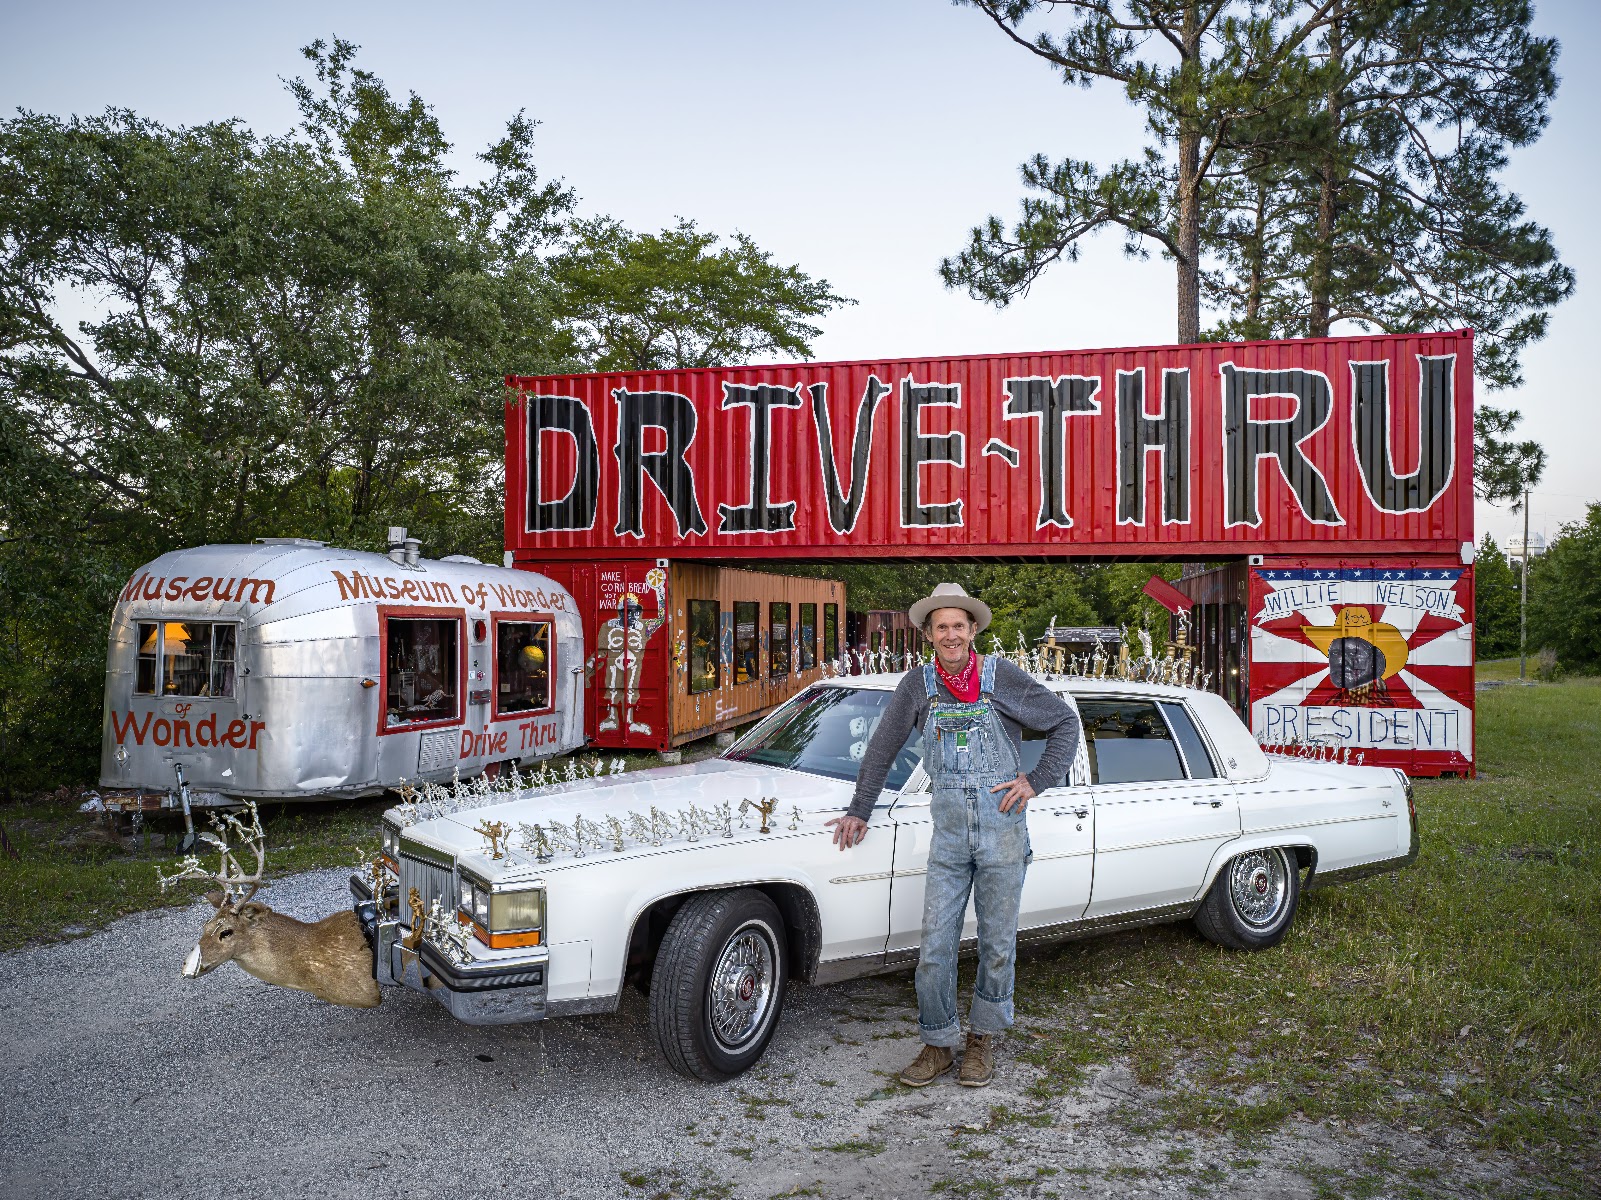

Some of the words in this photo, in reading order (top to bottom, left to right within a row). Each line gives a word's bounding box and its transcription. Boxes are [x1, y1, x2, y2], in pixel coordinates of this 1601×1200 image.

[524, 352, 1458, 539] DRIVE-THRU
[119, 572, 276, 605] Museum
[330, 570, 458, 605] Museum
[460, 585, 489, 611] of
[489, 583, 567, 612] Wonder
[600, 582, 625, 593] CORN
[628, 582, 650, 594] BREAD
[601, 571, 621, 581] MAKE
[599, 598, 617, 610] WAR
[1266, 583, 1339, 613] WILLIE
[1376, 582, 1450, 611] NELSON
[174, 702, 192, 719] of
[1266, 706, 1457, 747] PRESIDENT
[110, 709, 266, 750] Wonder
[460, 723, 508, 760] Drive
[518, 719, 557, 748] Thru
